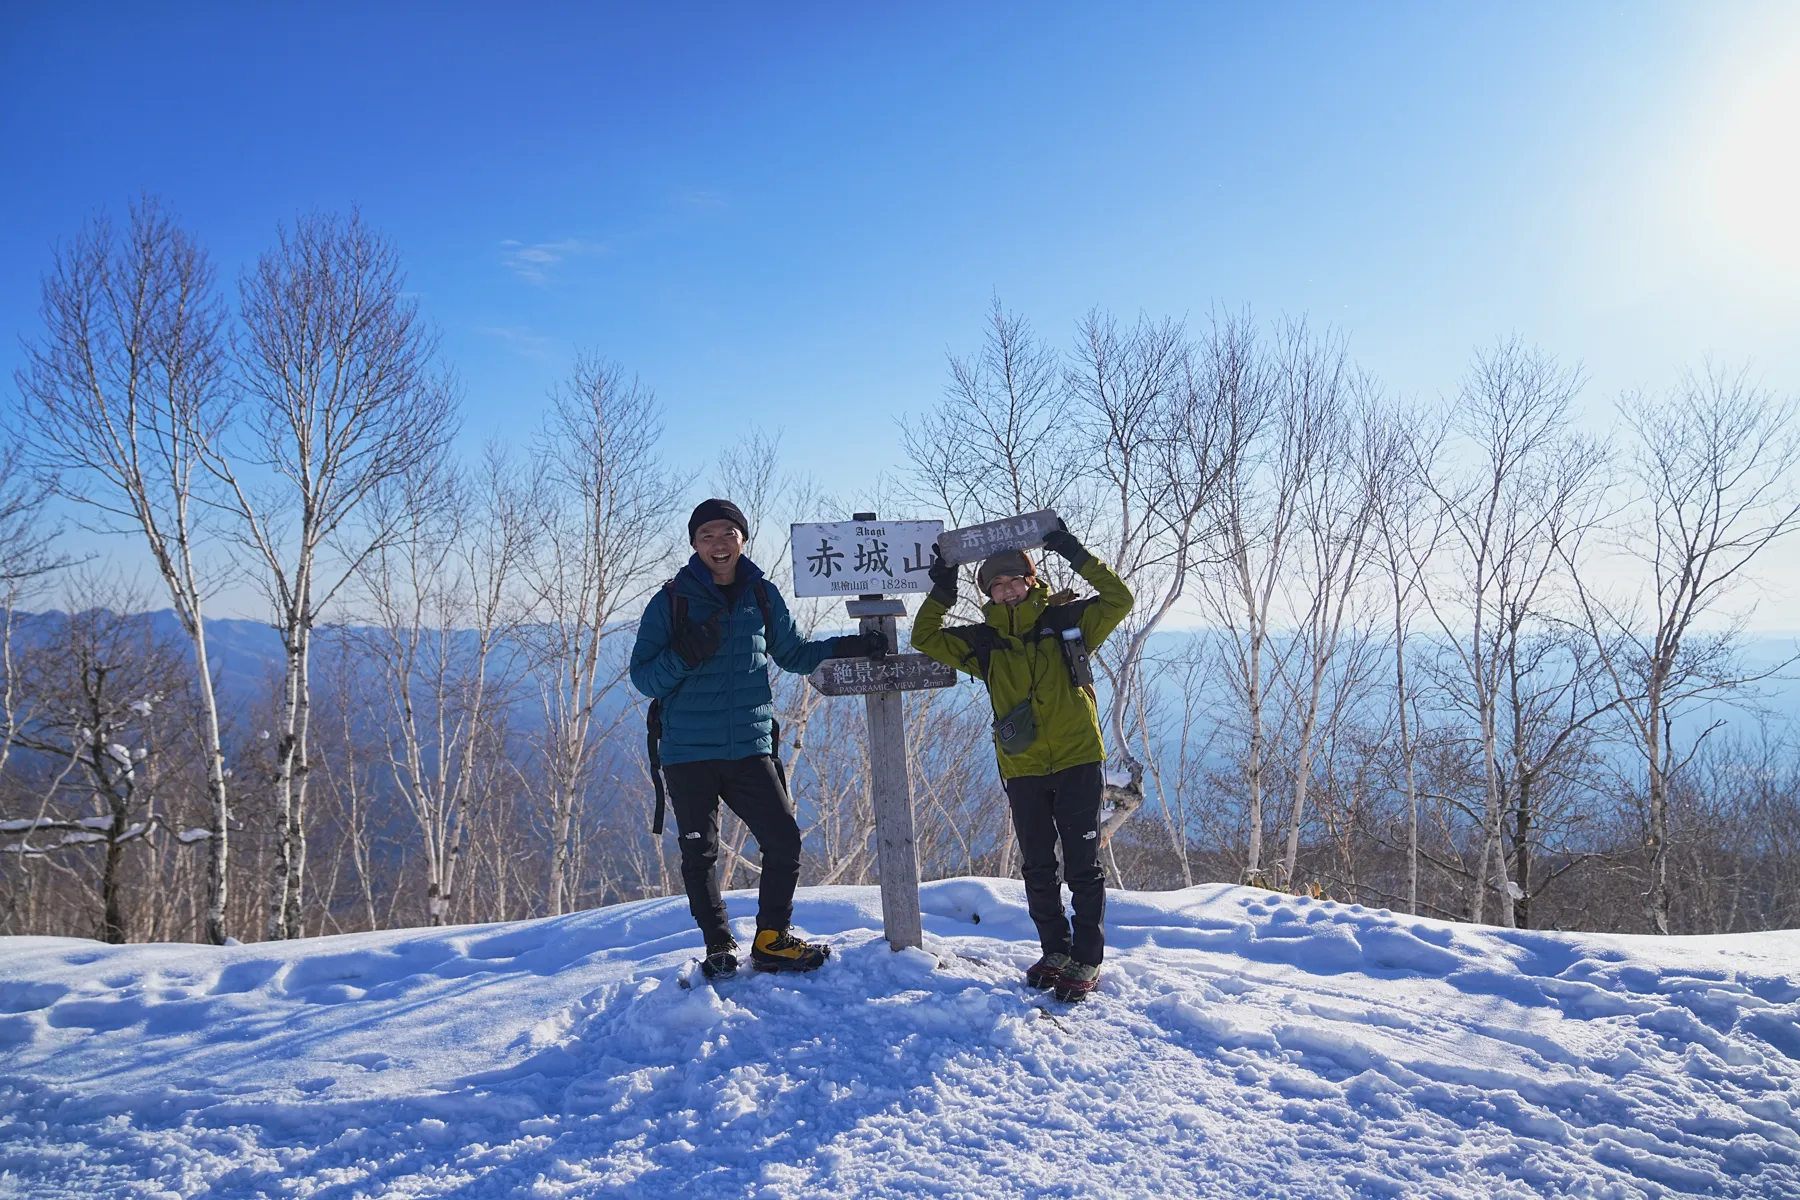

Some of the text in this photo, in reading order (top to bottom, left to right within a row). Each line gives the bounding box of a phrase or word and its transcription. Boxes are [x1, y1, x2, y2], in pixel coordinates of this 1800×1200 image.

[855, 526, 886, 536] Akagi
[961, 519, 1039, 548] 赤城山
[806, 538, 936, 578] 赤城山
[881, 579, 918, 590] 1828m
[833, 661, 926, 684] 絶景スポット
[839, 678, 944, 694] PANORAMIC VIEW 2min
